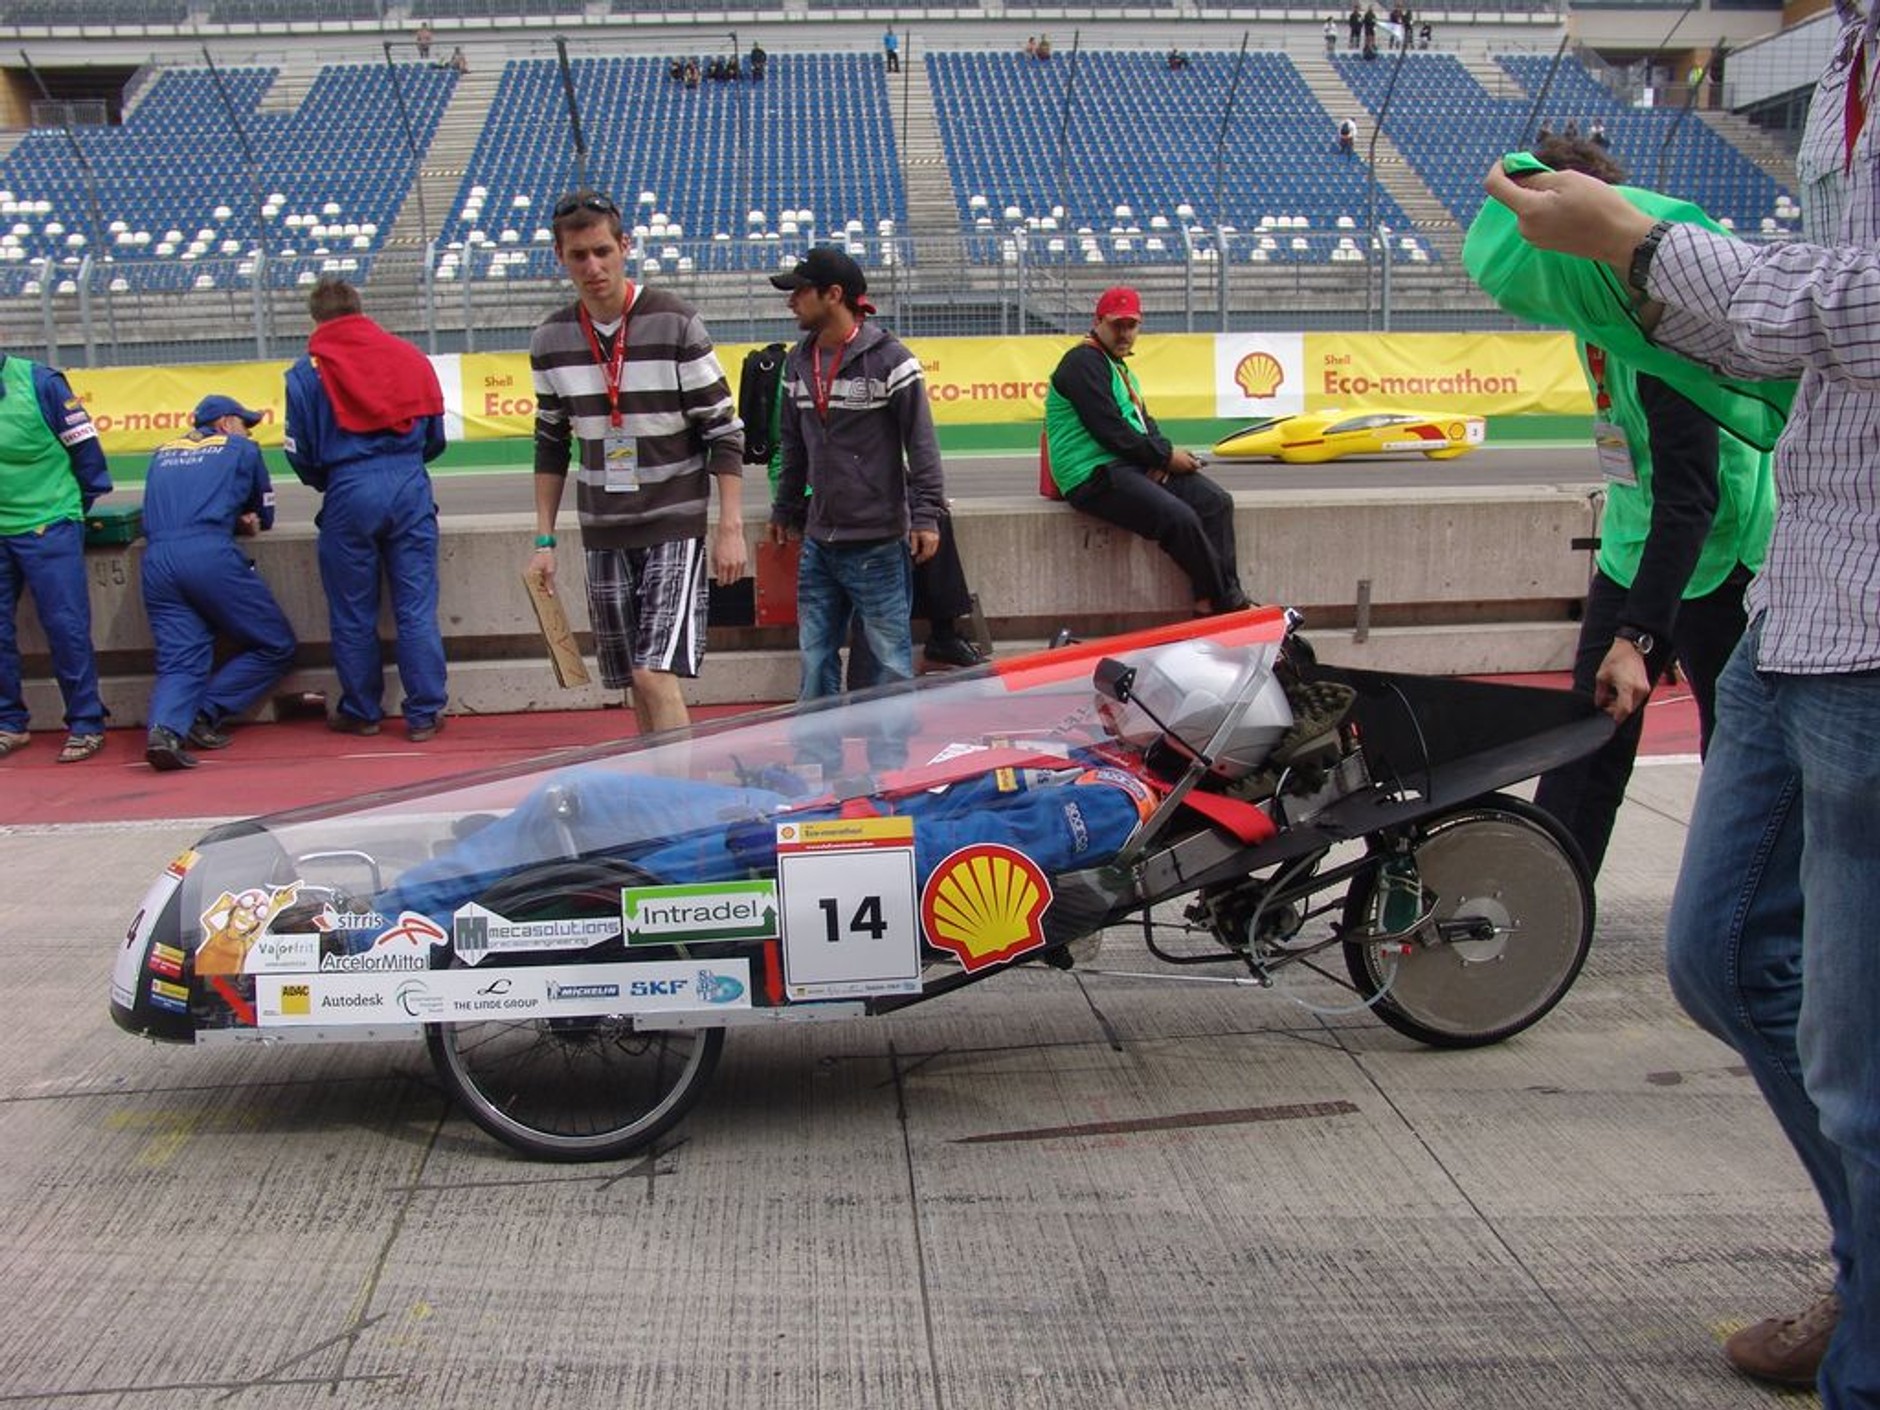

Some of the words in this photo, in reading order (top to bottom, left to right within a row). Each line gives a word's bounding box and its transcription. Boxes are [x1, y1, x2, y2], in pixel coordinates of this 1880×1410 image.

[1324, 354, 1351, 365] Shell
[485, 375, 513, 387] Shell
[1323, 369, 1518, 395] Eco-marathon
[644, 900, 757, 924] Intradel
[818, 895, 888, 943] 14
[337, 913, 383, 929] sirris
[488, 921, 618, 938] mecasolutions
[323, 953, 430, 970] ArcelorMittal
[282, 985, 310, 997] ADAC
[560, 985, 617, 997] MICHELIN
[630, 979, 689, 996] SKF
[321, 993, 384, 1008] Autodesk
[454, 1000, 472, 1010] THE
[474, 999, 502, 1010] LINDE
[503, 998, 539, 1010] GROUP
